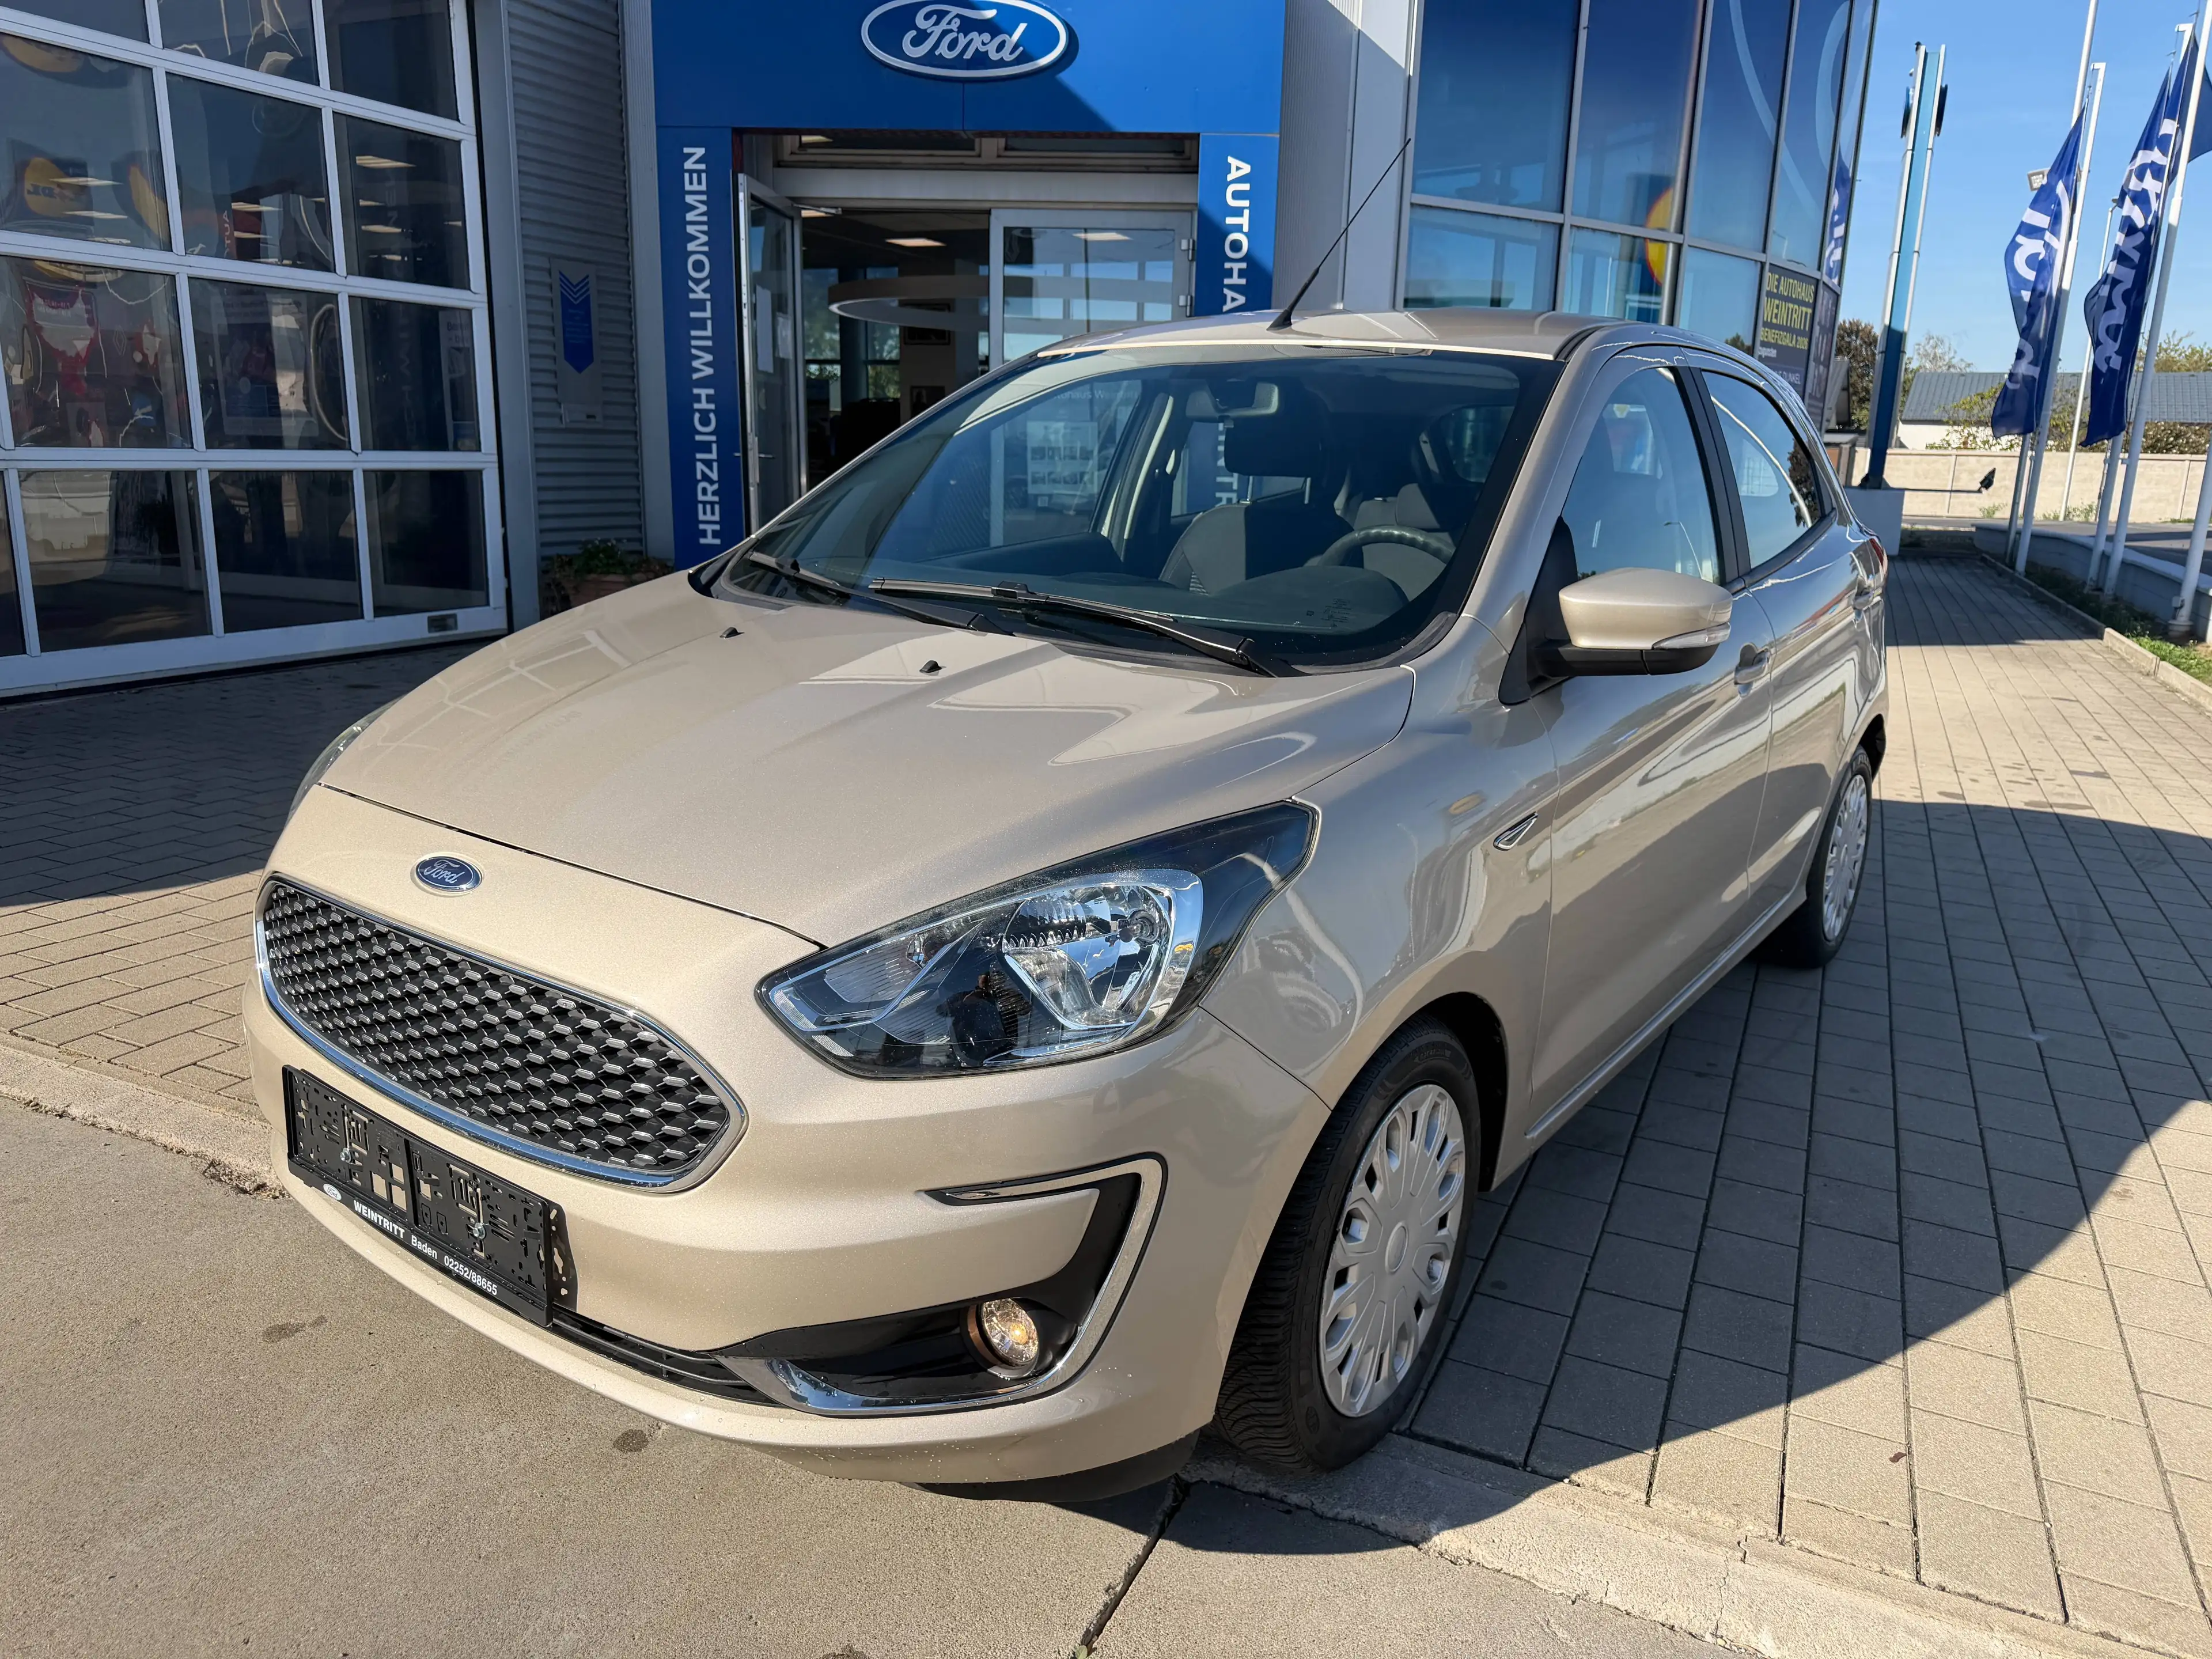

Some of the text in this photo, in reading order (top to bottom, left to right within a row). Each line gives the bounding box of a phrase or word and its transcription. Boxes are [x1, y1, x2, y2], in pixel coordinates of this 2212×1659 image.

[902, 4, 1028, 61] Ford
[1222, 156, 1251, 312] AUTOHA
[1764, 296, 1812, 331] WEINTRITT
[1767, 272, 1815, 303] DIE AUTOHAUS
[683, 147, 721, 544] HERZLICH WILLKOMMEN
[424, 859, 465, 884] Ford
[353, 1200, 405, 1238] WEINTRITT
[411, 1234, 437, 1260] Baden
[444, 1255, 498, 1296] 02252/88655
